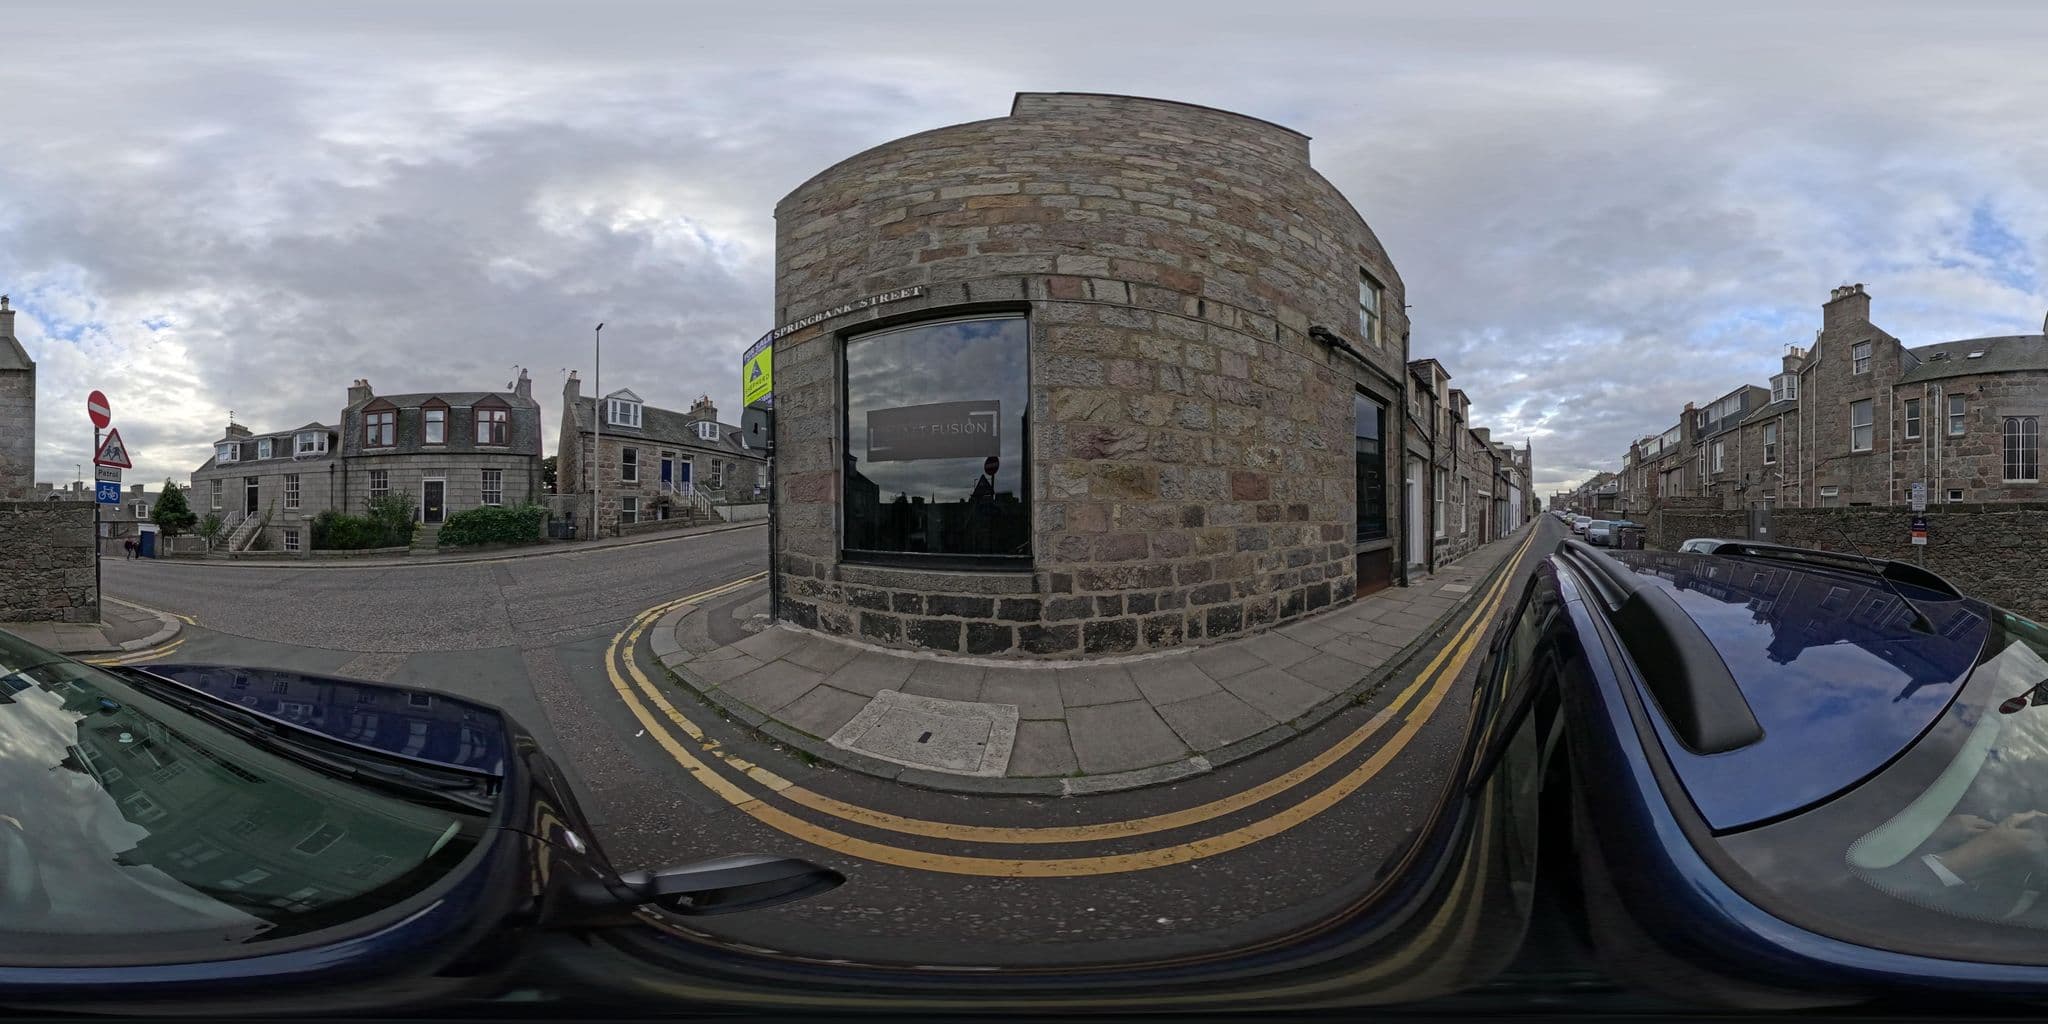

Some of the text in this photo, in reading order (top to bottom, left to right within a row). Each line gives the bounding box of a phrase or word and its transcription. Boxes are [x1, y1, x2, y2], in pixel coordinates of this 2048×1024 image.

[774, 286, 922, 339] SPRINGBANK STREET
[755, 332, 773, 354] SALE
[931, 422, 987, 435] FUSION
[98, 469, 119, 478] Patrol
